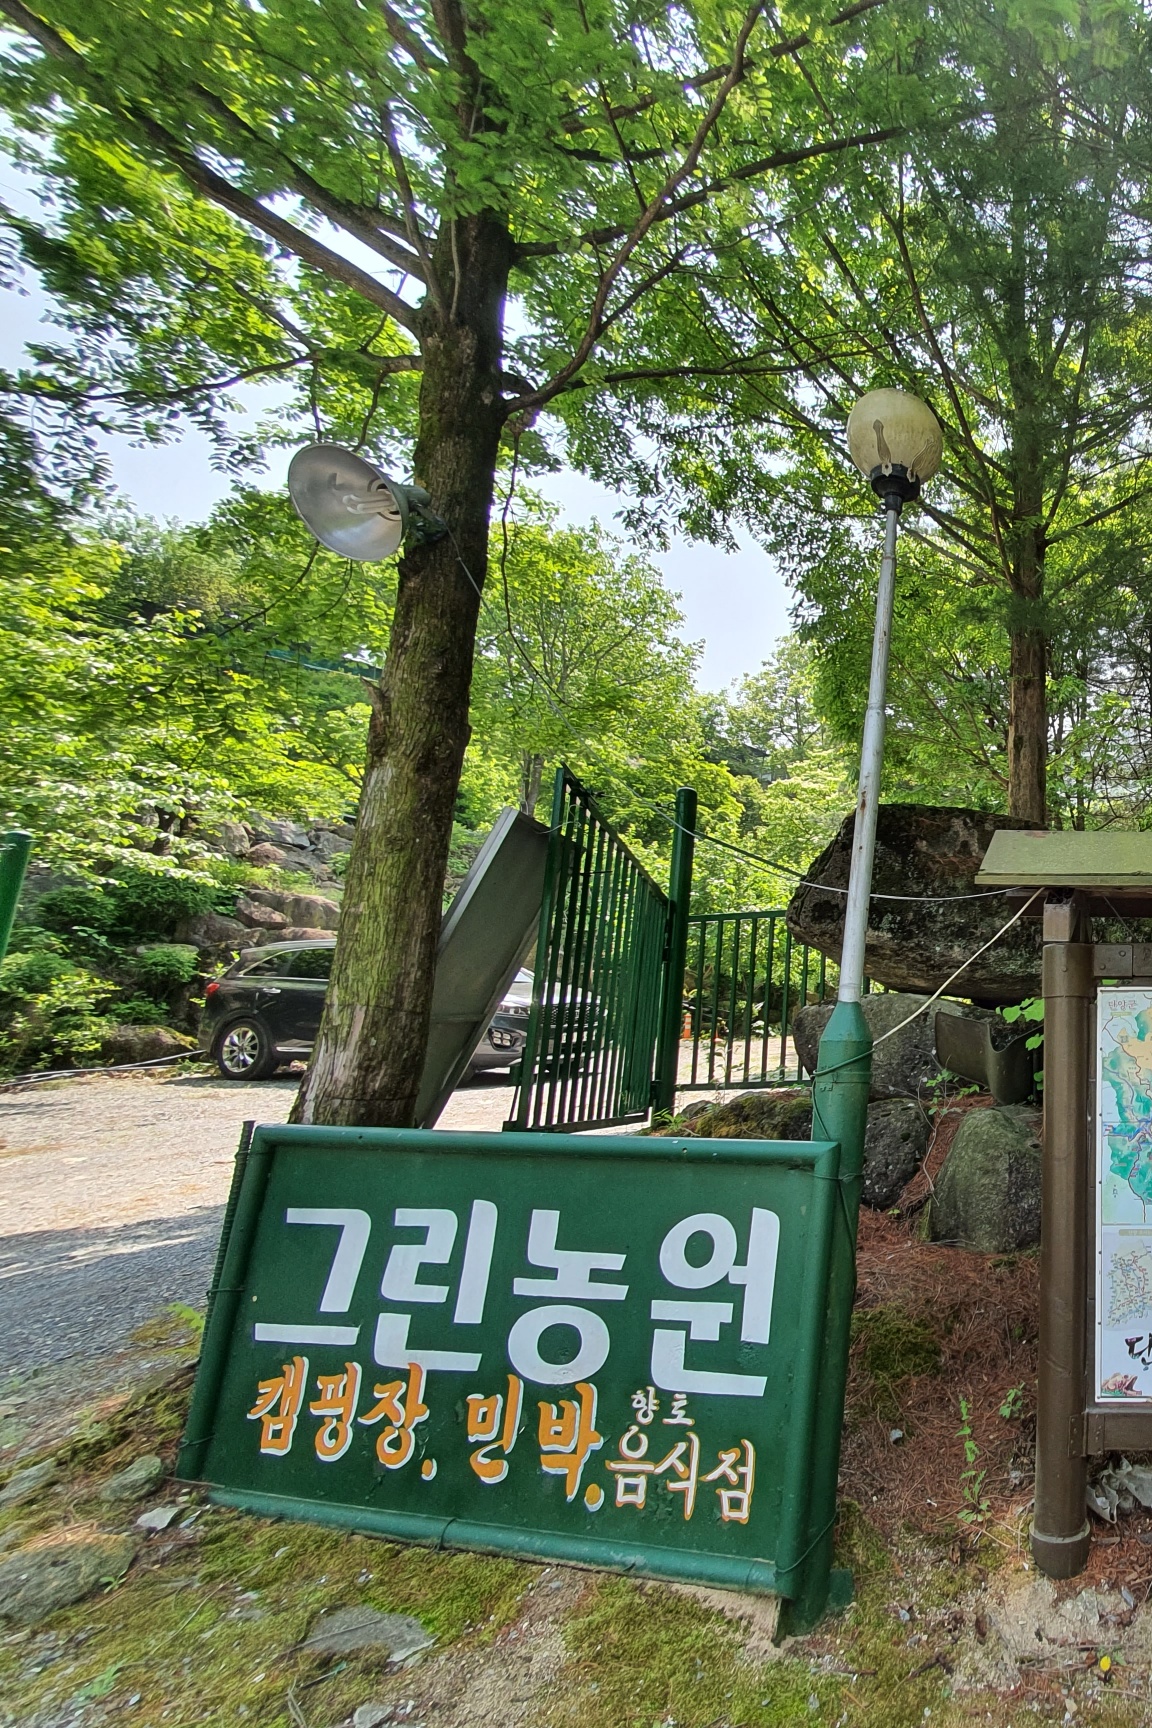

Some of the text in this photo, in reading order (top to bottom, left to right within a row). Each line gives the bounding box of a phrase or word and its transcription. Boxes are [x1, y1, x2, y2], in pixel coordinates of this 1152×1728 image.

[1108, 1000, 1137, 1010] 단양군
[254, 1199, 780, 1396] 그린농원
[631, 1386, 695, 1426] 향토
[605, 1426, 755, 1524] 음식점
